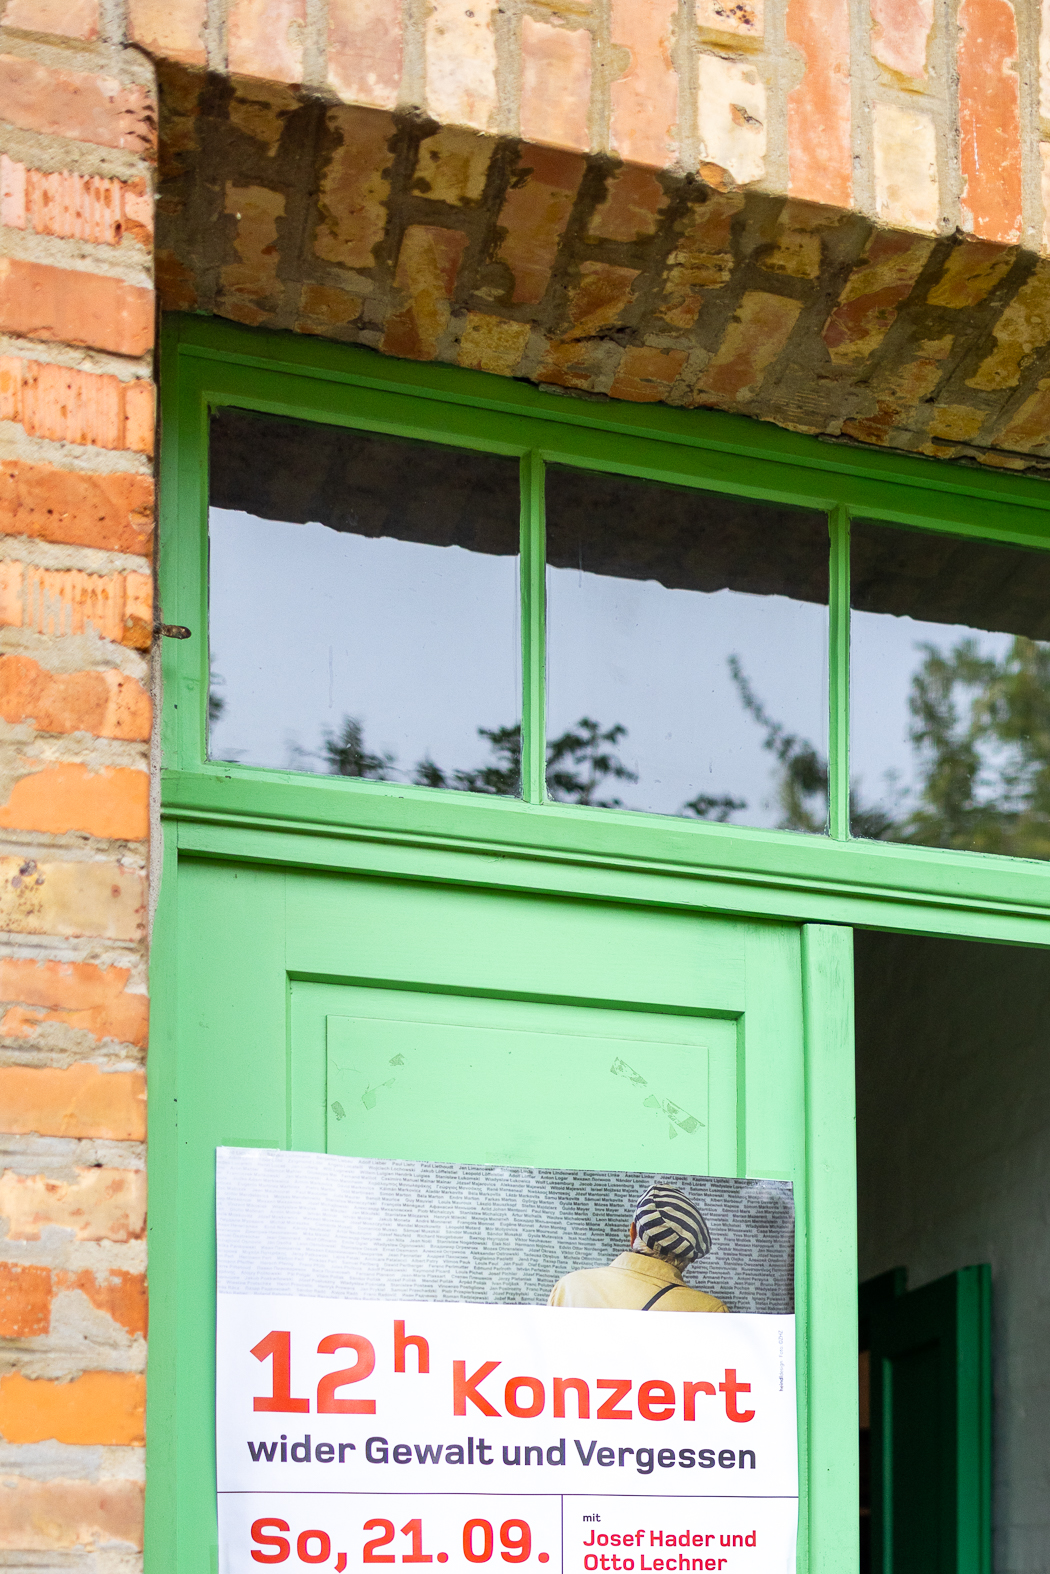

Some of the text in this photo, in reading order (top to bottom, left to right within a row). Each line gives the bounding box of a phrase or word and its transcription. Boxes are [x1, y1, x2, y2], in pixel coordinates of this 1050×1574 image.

[453, 1360, 756, 1423] Konzert
[247, 1434, 756, 1475] wider Gewalt und Vergessen
[583, 1513, 601, 1522] mit
[583, 1529, 756, 1547] Josef Hader und
[584, 1553, 727, 1571] Otto Lechner
